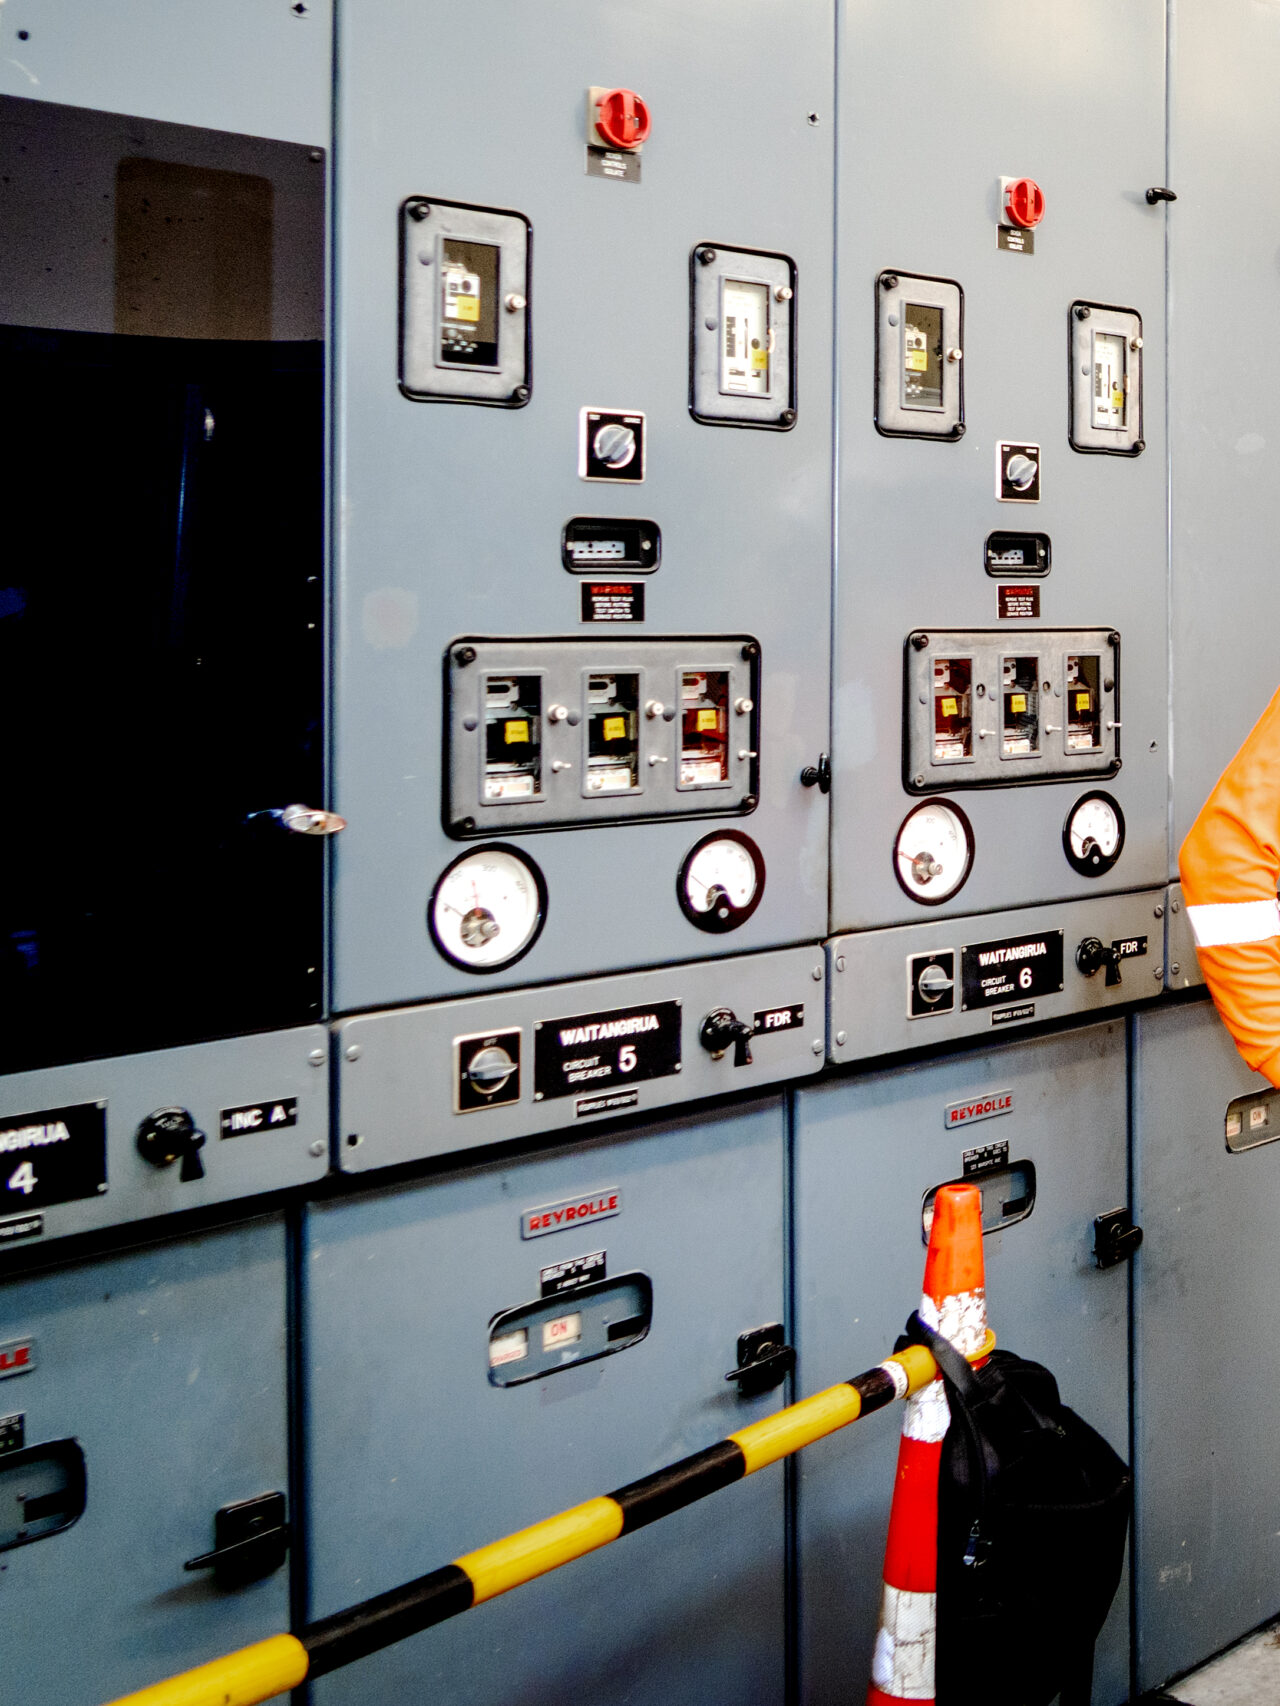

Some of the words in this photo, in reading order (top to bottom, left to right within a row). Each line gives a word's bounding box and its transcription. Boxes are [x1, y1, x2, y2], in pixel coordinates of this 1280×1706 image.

[979, 942, 1046, 966] WAITANGIRUA
[1120, 941, 1138, 955] FDR
[981, 975, 1006, 988] CIRCUIT
[1020, 967, 1032, 989] 6
[985, 983, 1015, 997] BREAKER
[559, 1015, 659, 1046] WAITANGIRUA
[765, 1011, 791, 1029] FDR
[563, 1056, 600, 1072] CIRCUIT
[618, 1045, 637, 1073] 5
[567, 1066, 612, 1083] BREAKER
[231, 1109, 263, 1131] INC
[270, 1105, 287, 1123] A
[950, 1096, 1012, 1122] REYROLLE
[8, 1161, 38, 1194] 4
[529, 1195, 618, 1231] REYROLLE
[550, 1322, 567, 1337] ON
